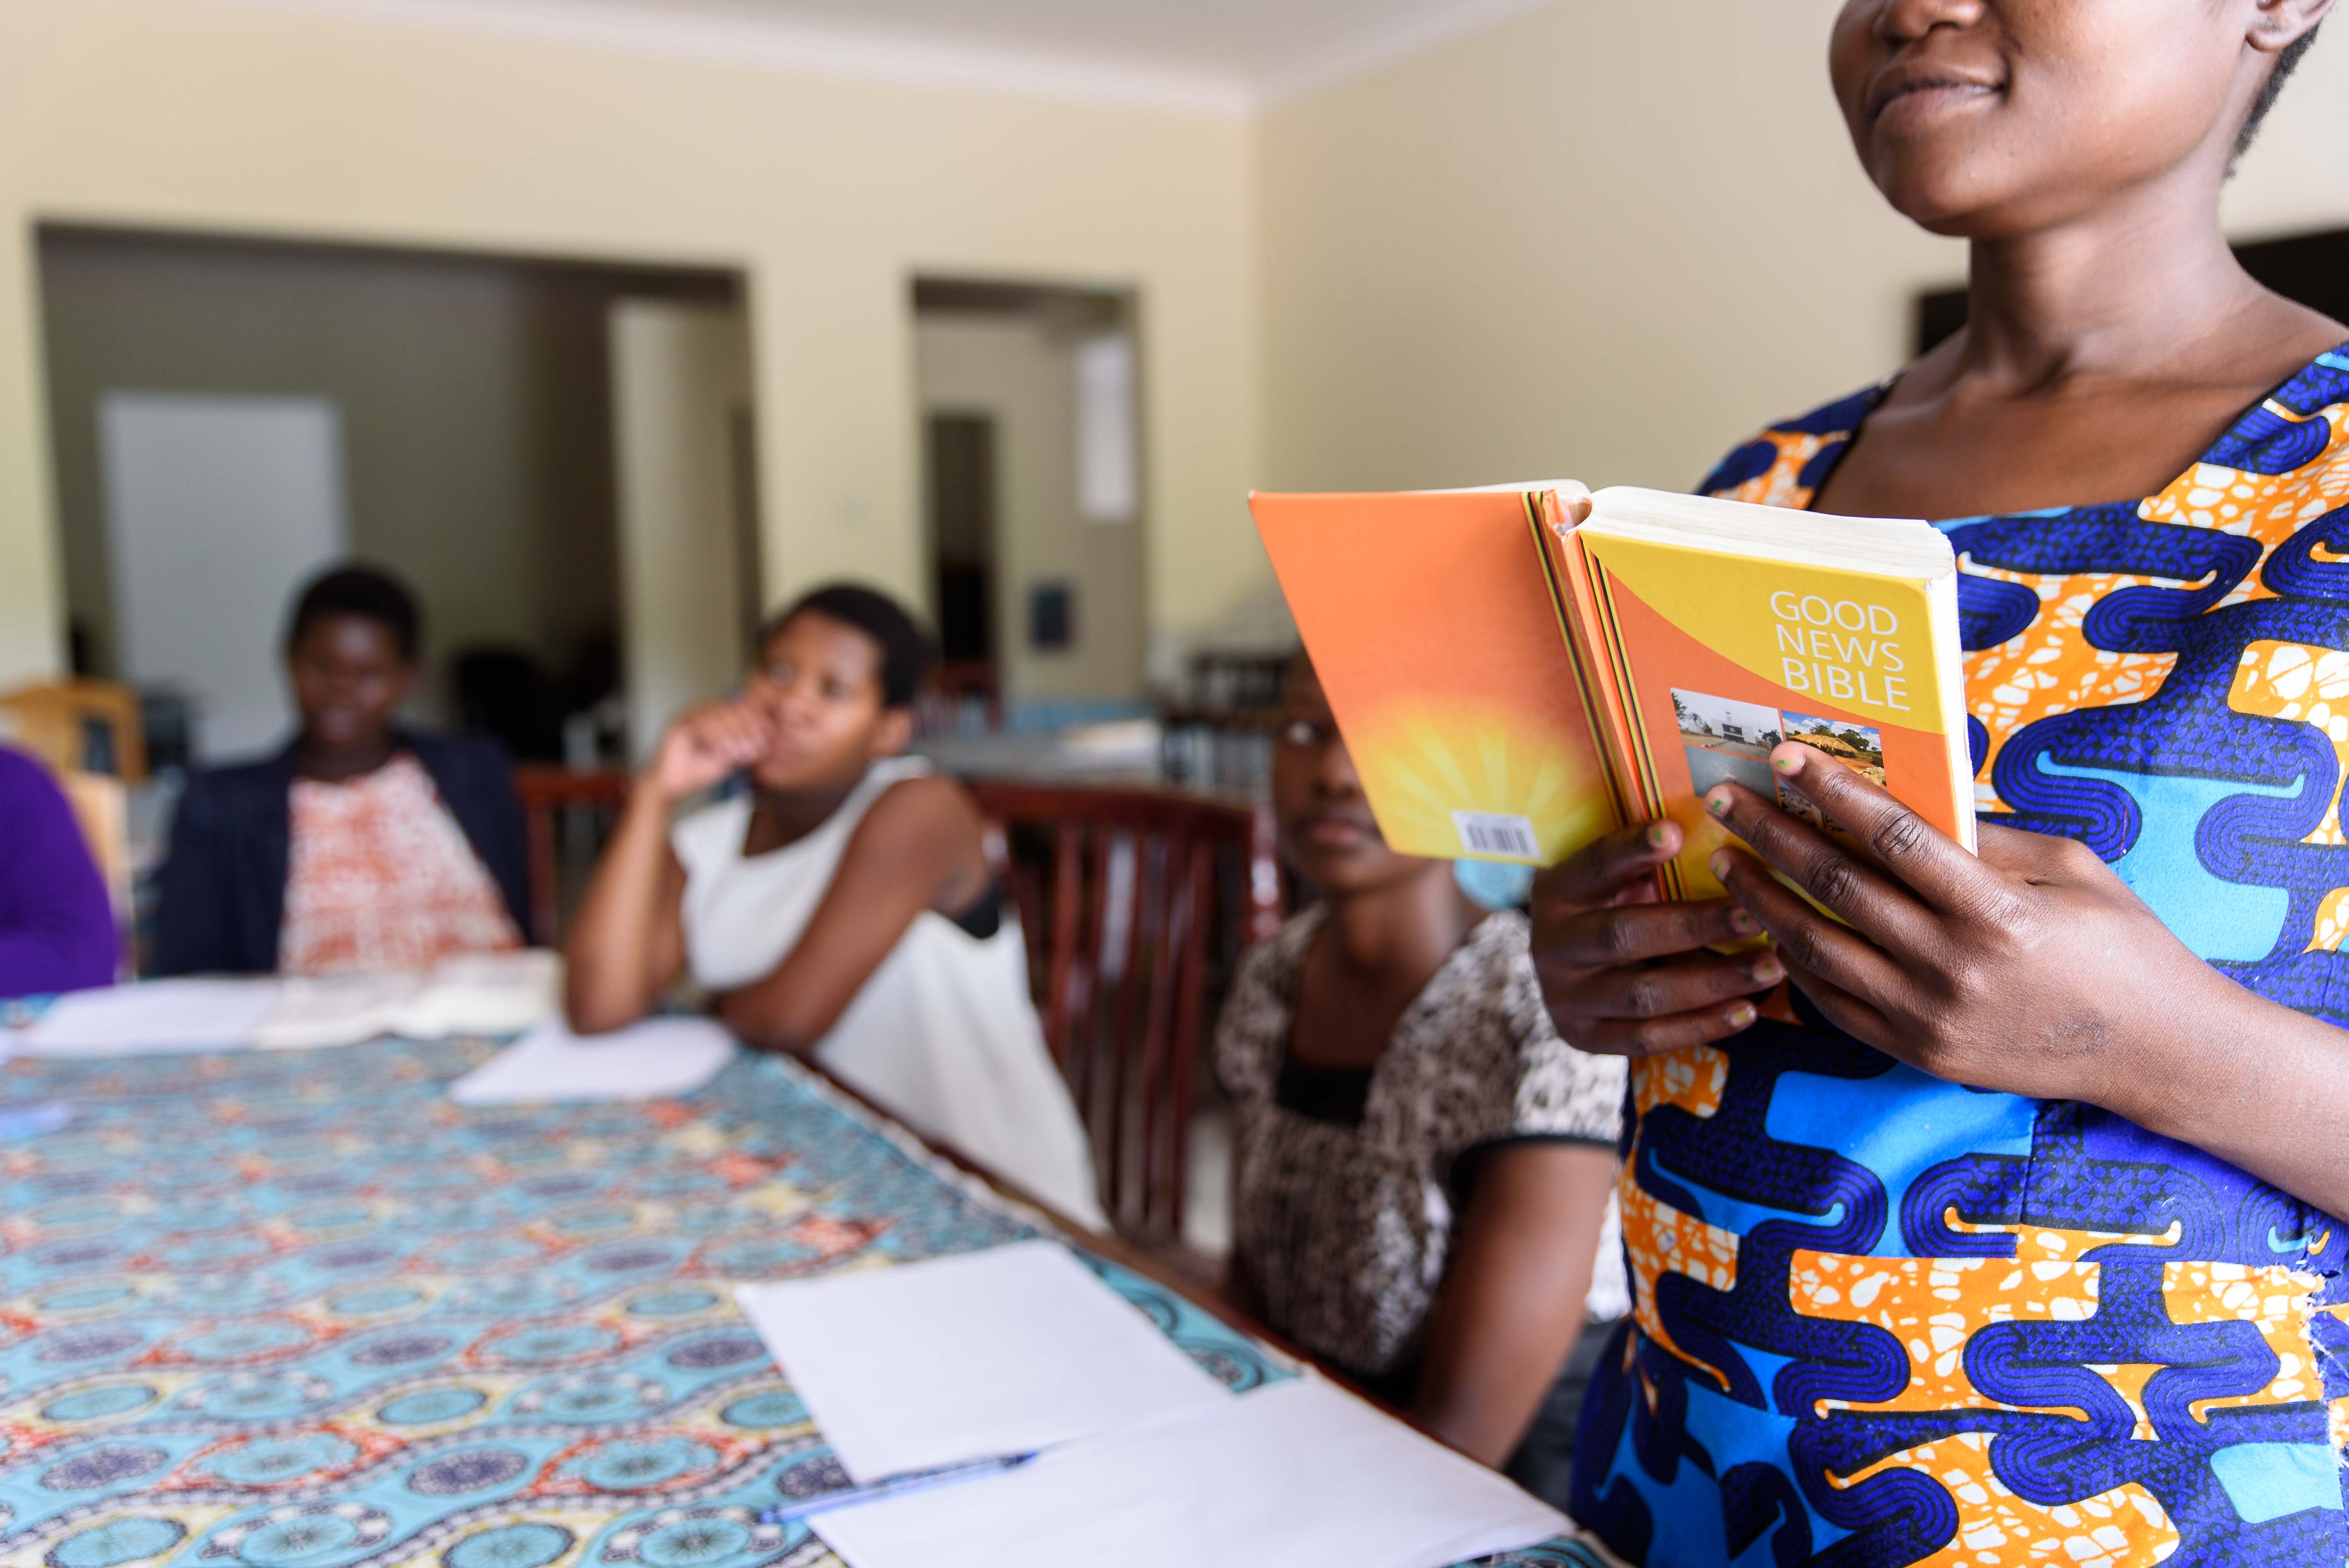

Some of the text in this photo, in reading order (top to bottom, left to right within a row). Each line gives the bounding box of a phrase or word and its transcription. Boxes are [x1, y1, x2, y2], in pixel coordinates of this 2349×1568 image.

[1770, 591, 1898, 635] GOOD
[1776, 624, 1904, 672] NEWS
[1782, 657, 1911, 711] BIBLE
